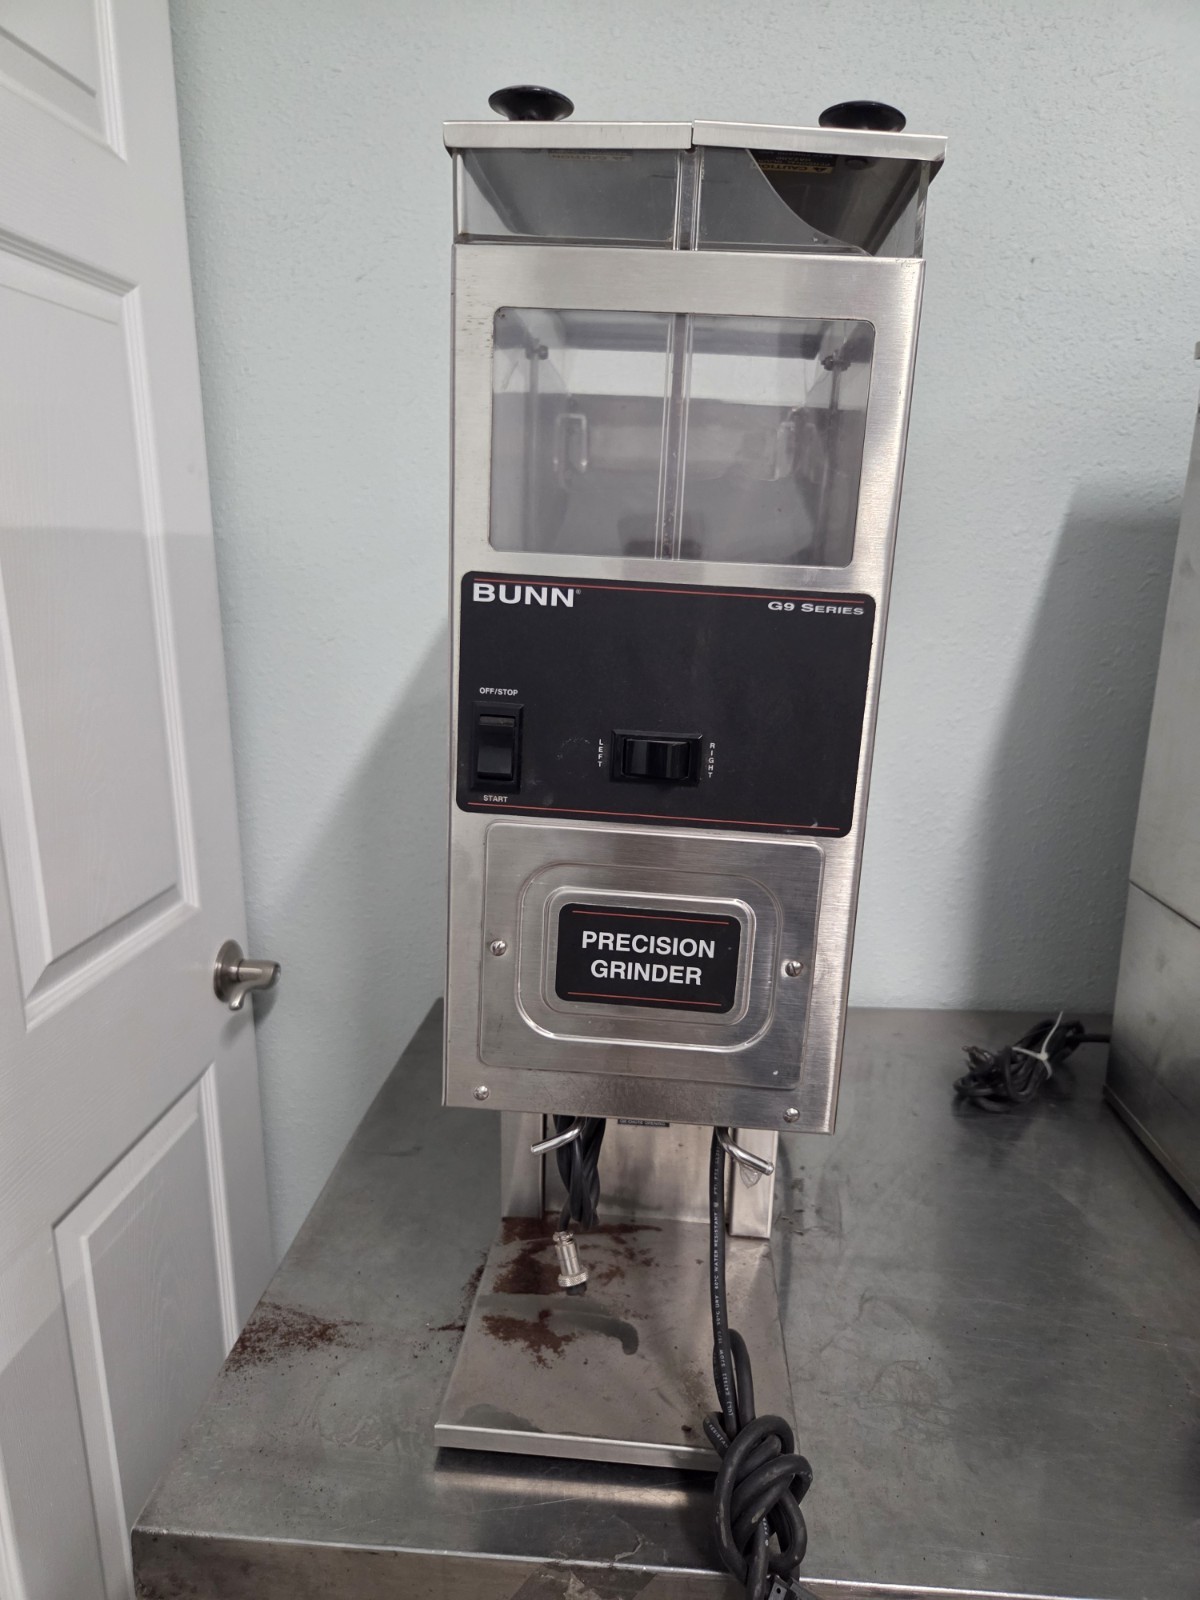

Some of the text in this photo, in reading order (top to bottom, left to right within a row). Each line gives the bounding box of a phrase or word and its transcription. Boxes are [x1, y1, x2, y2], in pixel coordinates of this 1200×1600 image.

[758, 164, 808, 173] CAUTIO
[767, 601, 795, 611] G9
[479, 686, 518, 696] OFF/STOP
[483, 794, 508, 803] START
[582, 930, 715, 958] PRECISION
[590, 959, 702, 985] GRINDER
